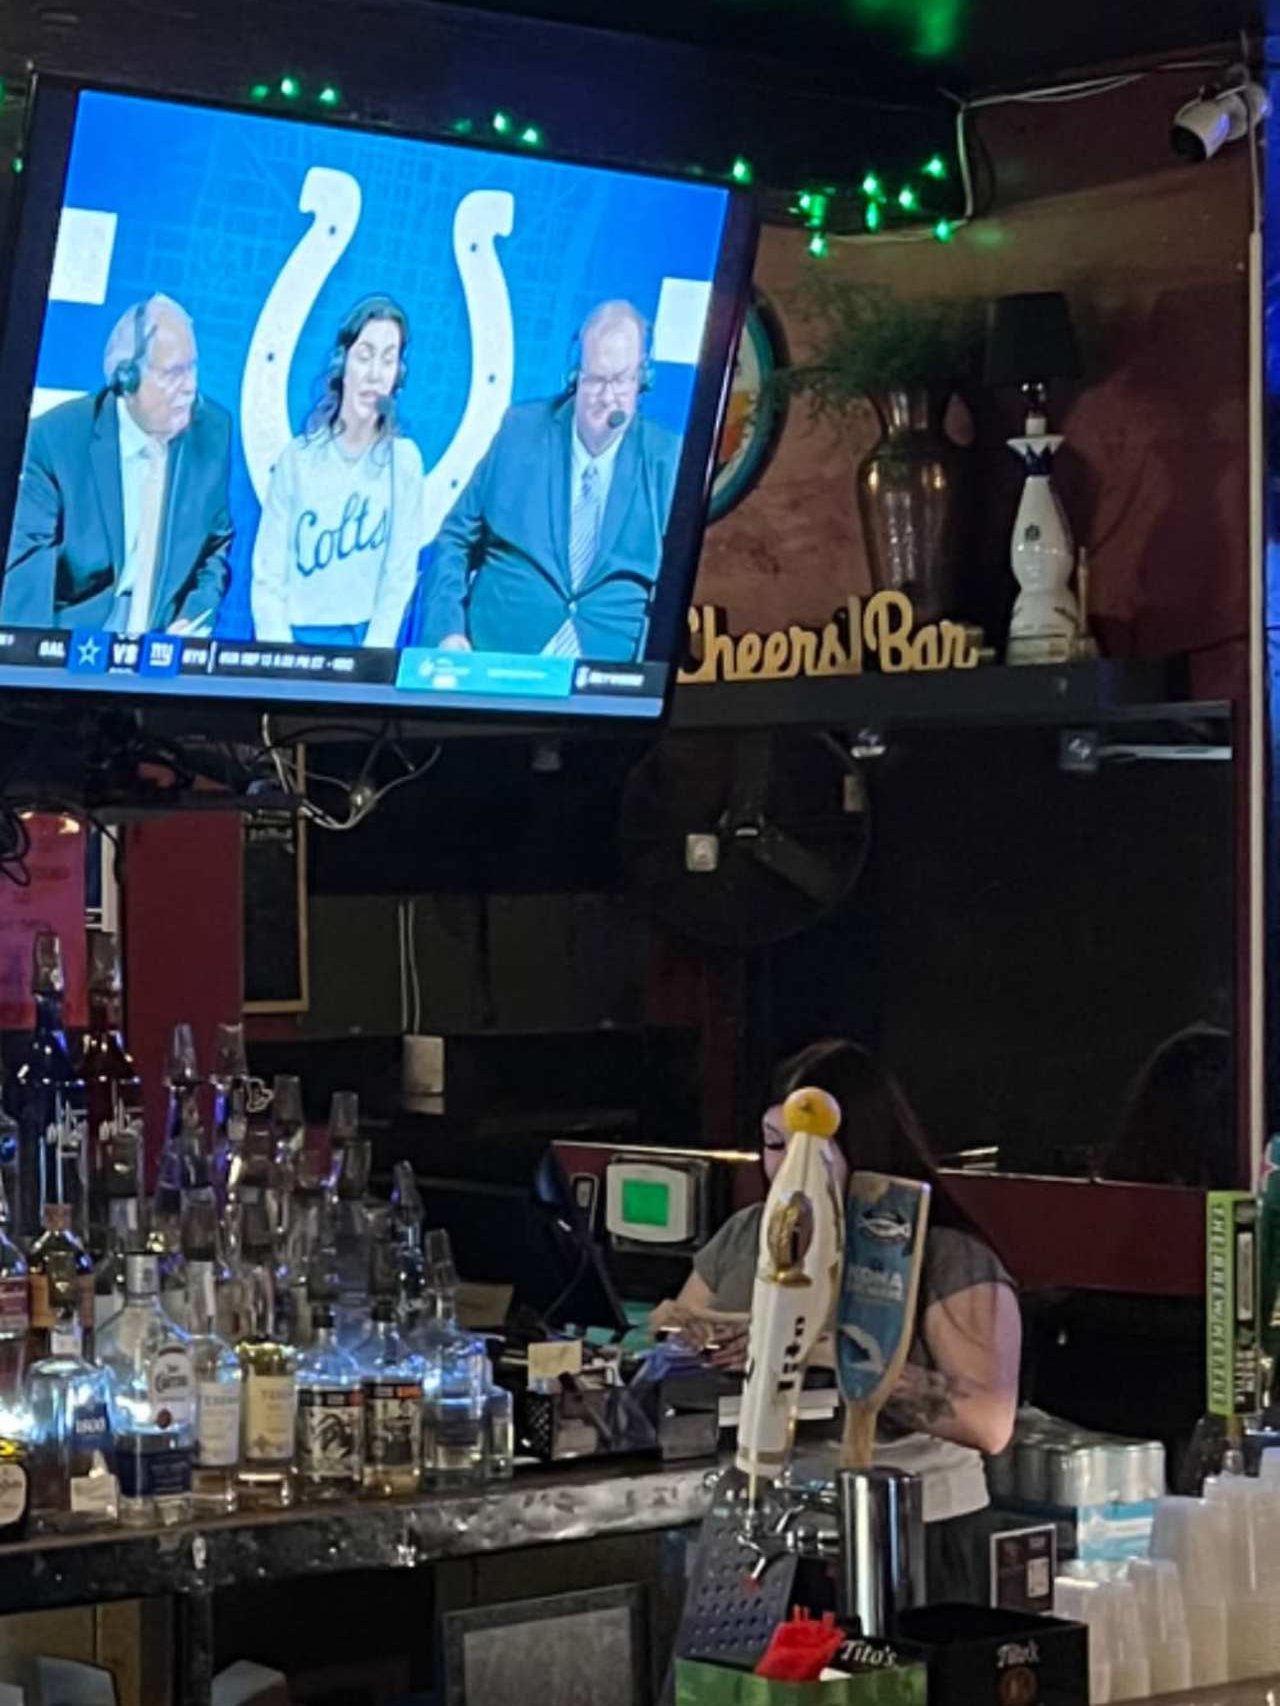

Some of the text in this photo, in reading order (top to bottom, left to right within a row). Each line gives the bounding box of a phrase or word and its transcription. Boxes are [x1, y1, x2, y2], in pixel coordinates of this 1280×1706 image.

[294, 491, 387, 577] Colts
[863, 590, 979, 674] Bar
[840, 1638, 899, 1667] Tito's
